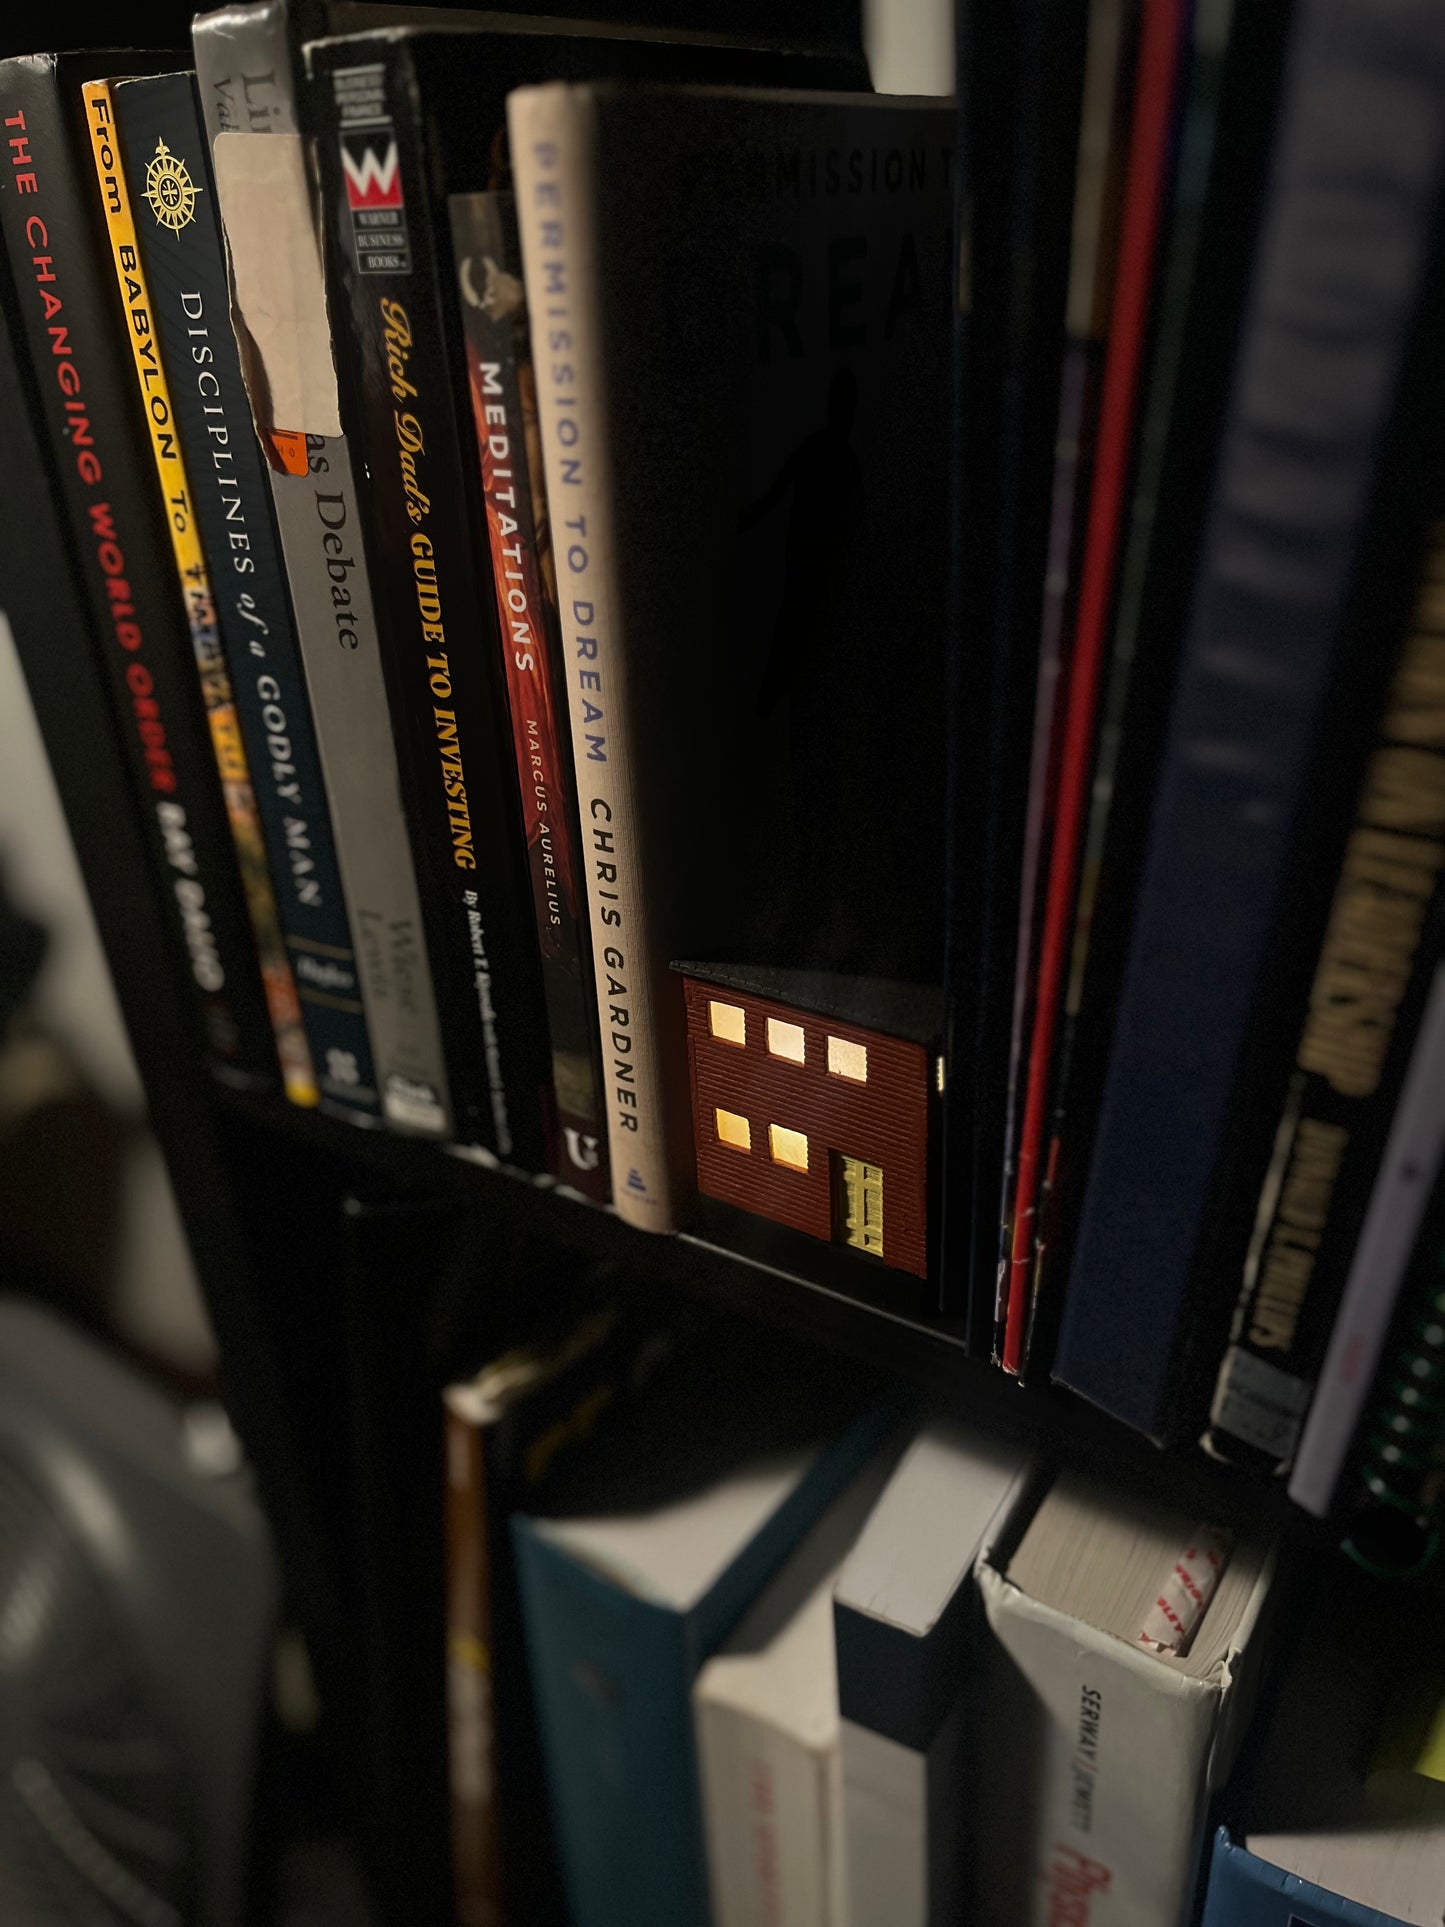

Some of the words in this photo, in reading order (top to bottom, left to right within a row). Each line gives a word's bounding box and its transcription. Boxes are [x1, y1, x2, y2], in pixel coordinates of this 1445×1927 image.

[91, 98, 122, 214] From
[118, 245, 177, 460] BABYLON
[367, 255, 400, 269] BOOKS
[532, 141, 584, 486] PERMISSION
[4, 110, 40, 195] THE
[25, 214, 103, 486] CHANGING
[88, 501, 144, 653] WORLD
[379, 296, 419, 405] Rich
[314, 488, 360, 650] Debate
[409, 531, 446, 644] GUIDE
[479, 361, 535, 672] MEDITATIONS
[565, 514, 590, 574] TO
[180, 289, 256, 575] DISCIPLINES
[236, 592, 271, 636] of
[256, 673, 302, 804] GODLY
[282, 816, 324, 909] MAN
[425, 651, 453, 700] TO
[572, 600, 608, 763] DREAM
[433, 706, 478, 871] INVESTING
[526, 718, 549, 812] MARCUS
[538, 821, 561, 926] AURELIUS
[590, 798, 622, 928] CHRIS
[603, 945, 639, 1133] GARDNER
